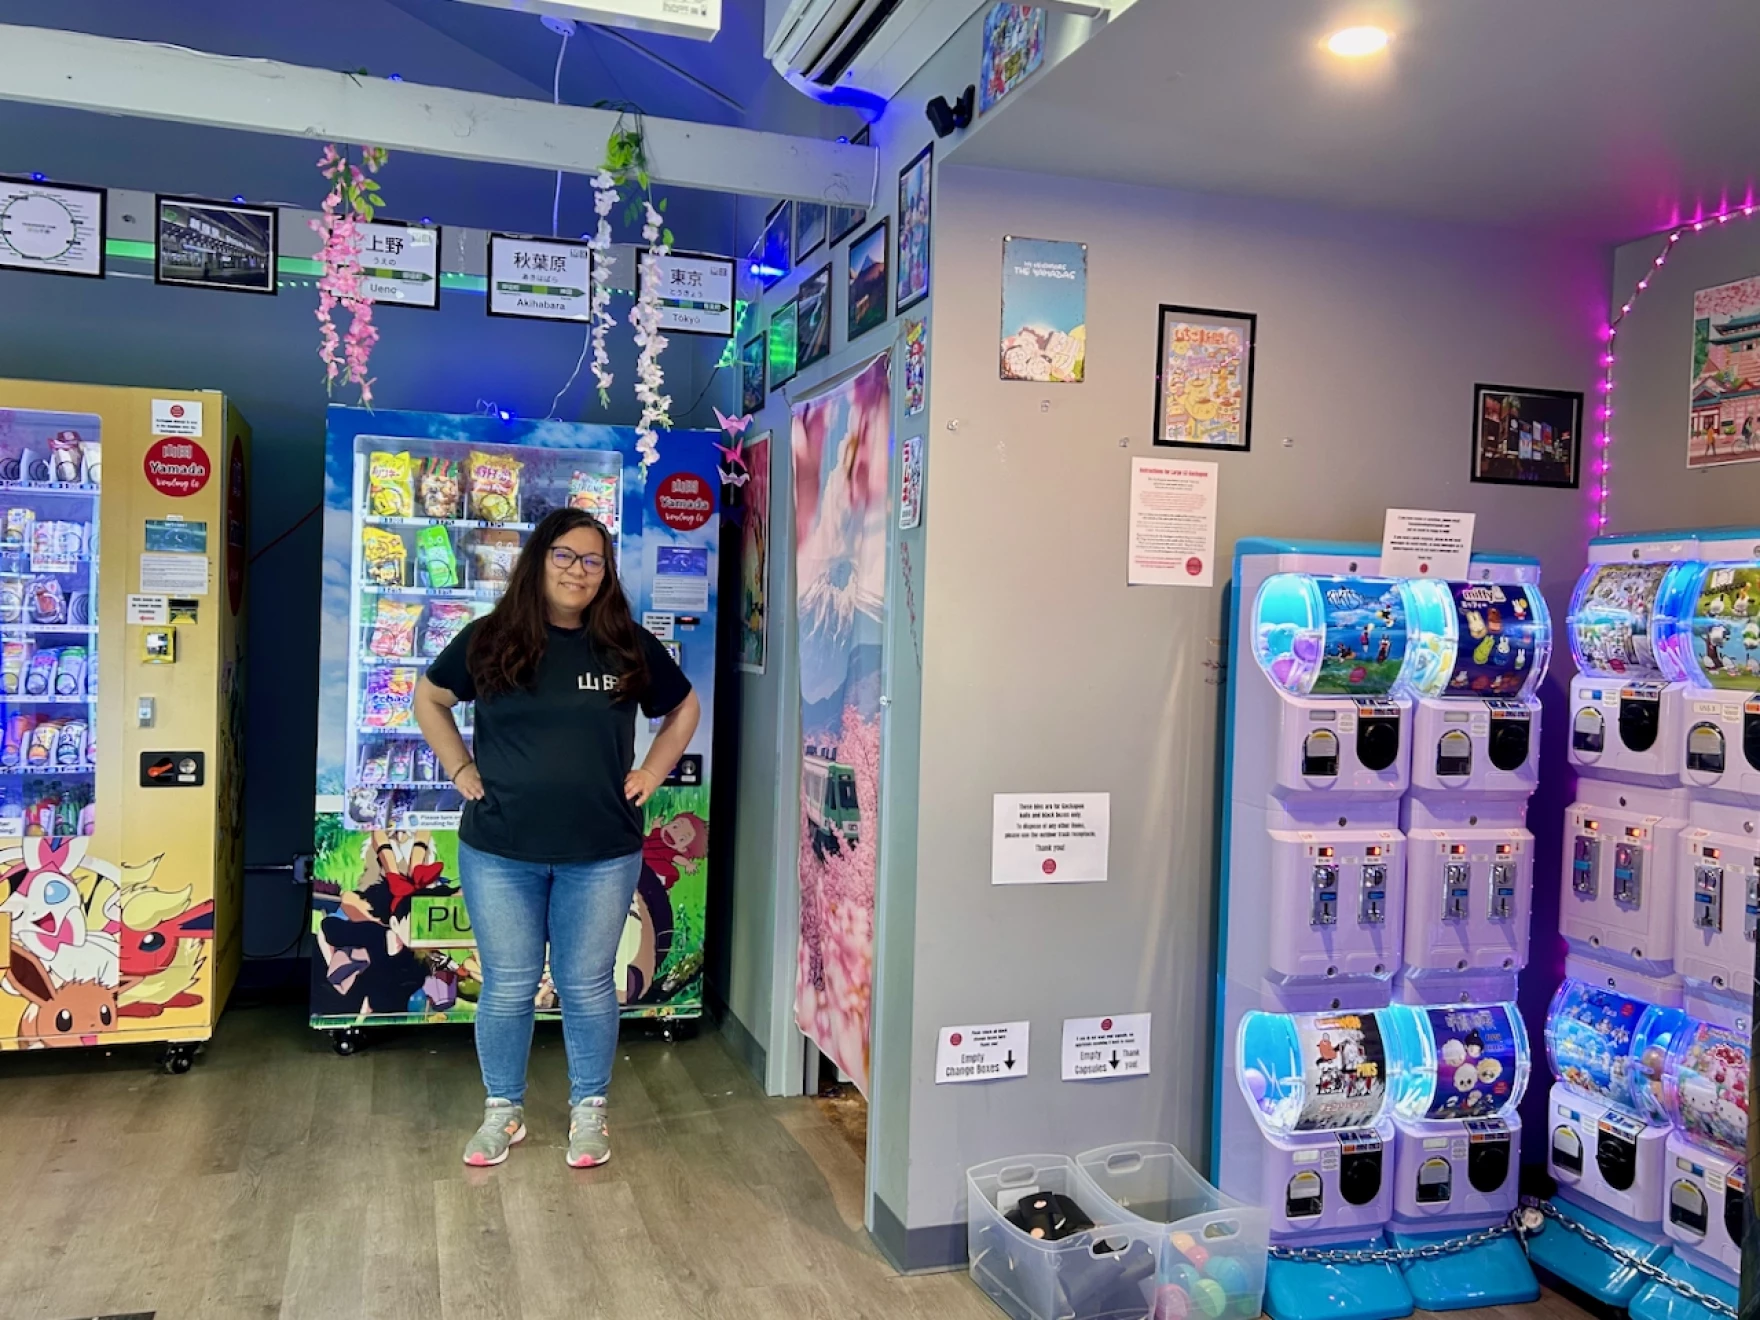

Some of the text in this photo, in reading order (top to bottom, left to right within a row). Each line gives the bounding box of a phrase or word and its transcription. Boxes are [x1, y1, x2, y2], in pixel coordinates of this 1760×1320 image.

[365, 234, 404, 255] 上野
[373, 257, 397, 266] うえの
[513, 251, 568, 272] 秋葉原
[670, 268, 703, 286] 東京
[1014, 266, 1030, 276] THE
[370, 283, 398, 295] Ueno
[516, 298, 566, 310] Akihabara
[149, 460, 205, 477] Yamada
[659, 495, 709, 510] Yamada
[1463, 589, 1493, 602] miffy
[961, 1053, 985, 1064] Empty
[1080, 1050, 1101, 1060] Empty
[946, 1063, 1000, 1077] Change Boxes
[1074, 1063, 1107, 1074] Capsules
[1356, 1062, 1378, 1077] PINS
